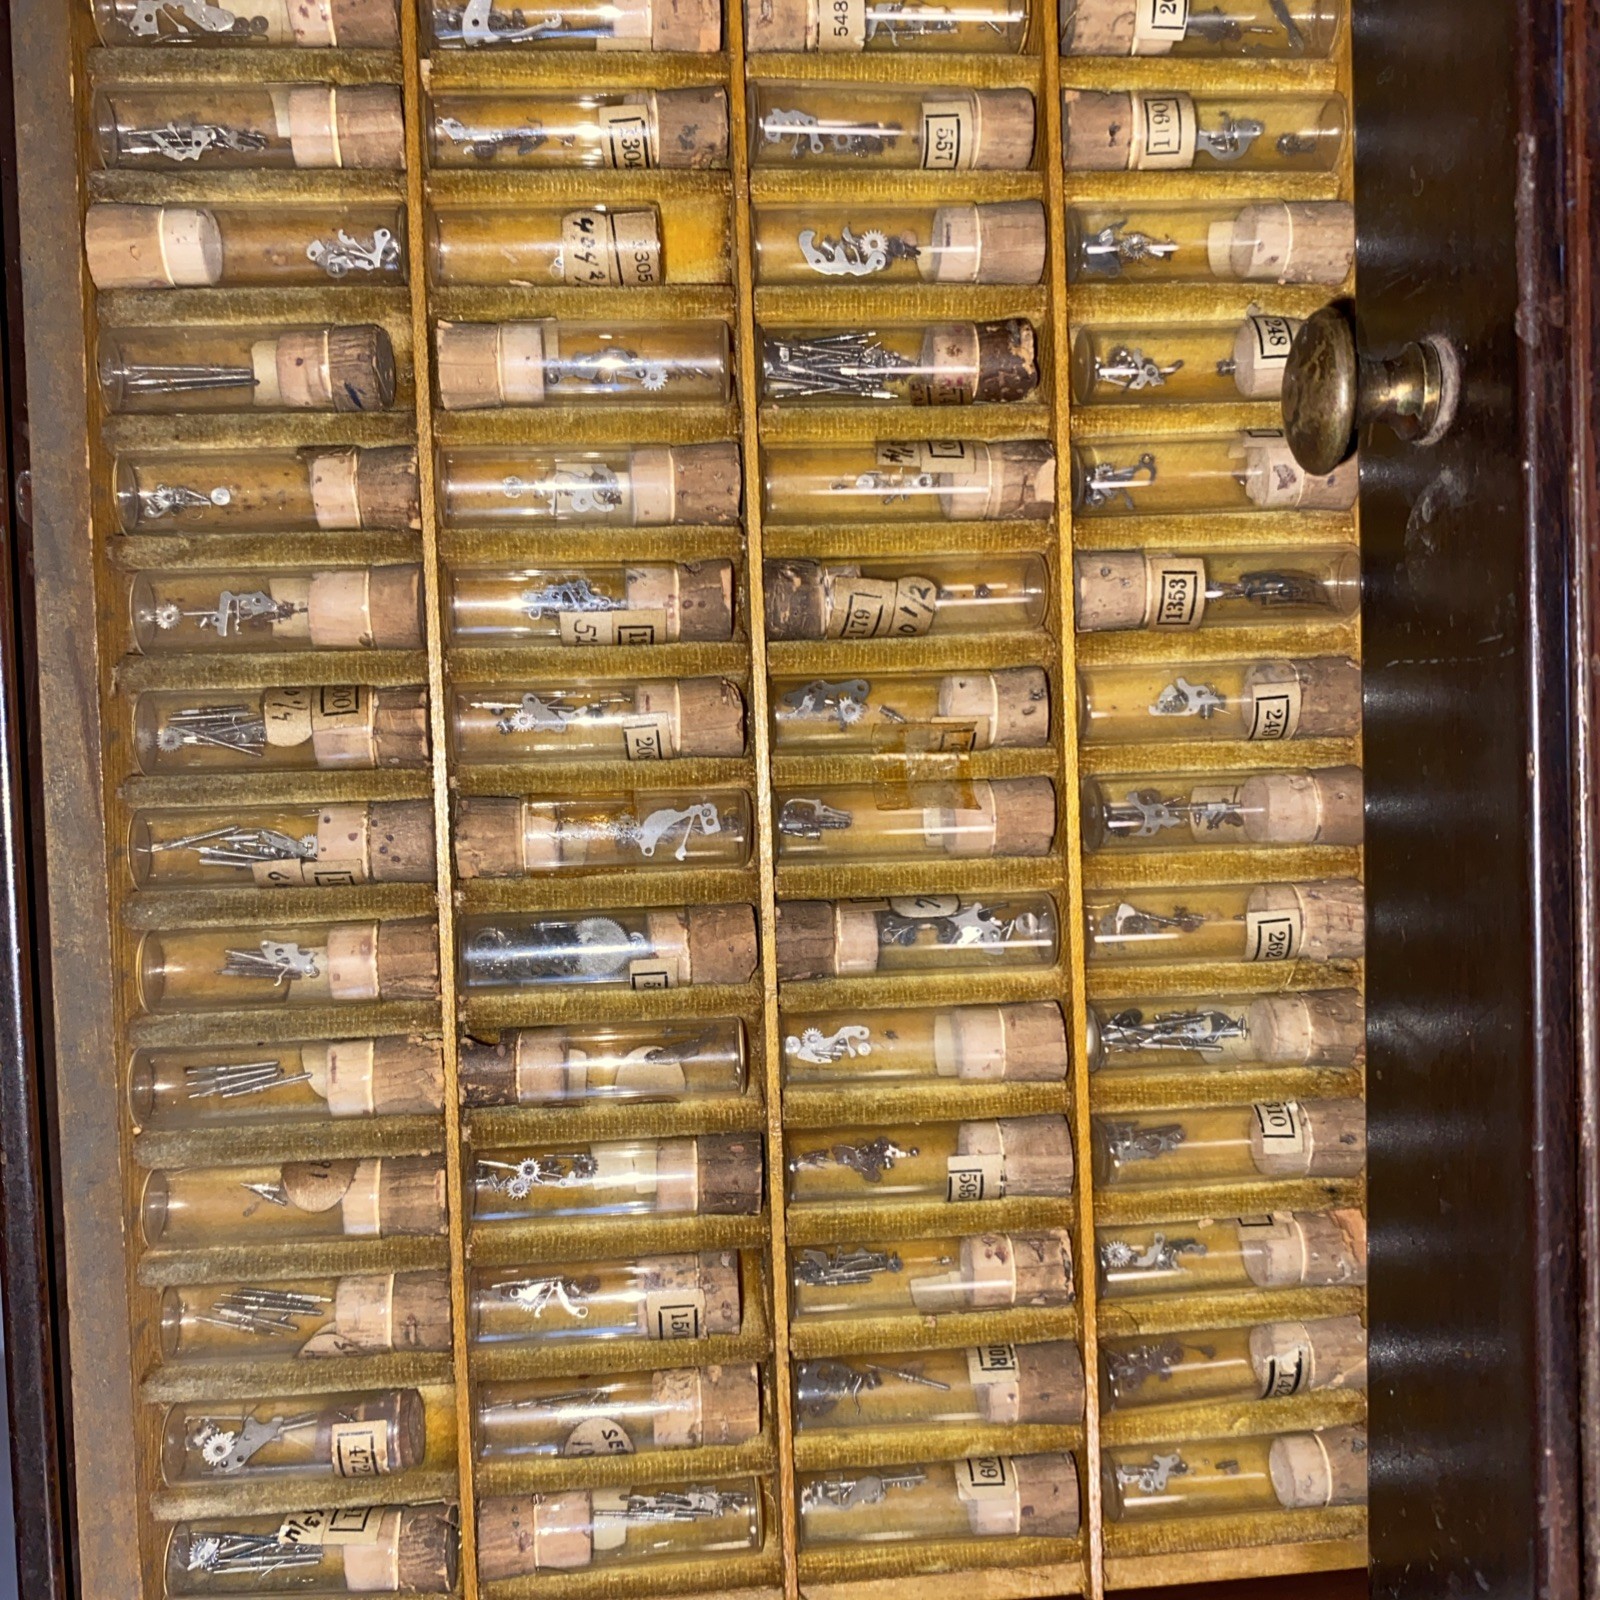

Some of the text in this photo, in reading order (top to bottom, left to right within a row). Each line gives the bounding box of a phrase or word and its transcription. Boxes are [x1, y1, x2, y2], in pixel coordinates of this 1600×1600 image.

[1161, 0, 1175, 14] 2
[621, 128, 641, 169] 304
[936, 128, 954, 162] 557
[633, 240, 653, 282] 305
[1265, 319, 1286, 346] 248
[1166, 578, 1187, 619] 1353
[1261, 709, 1283, 737] 249
[1266, 931, 1285, 957] 262
[350, 1446, 370, 1473] 472
